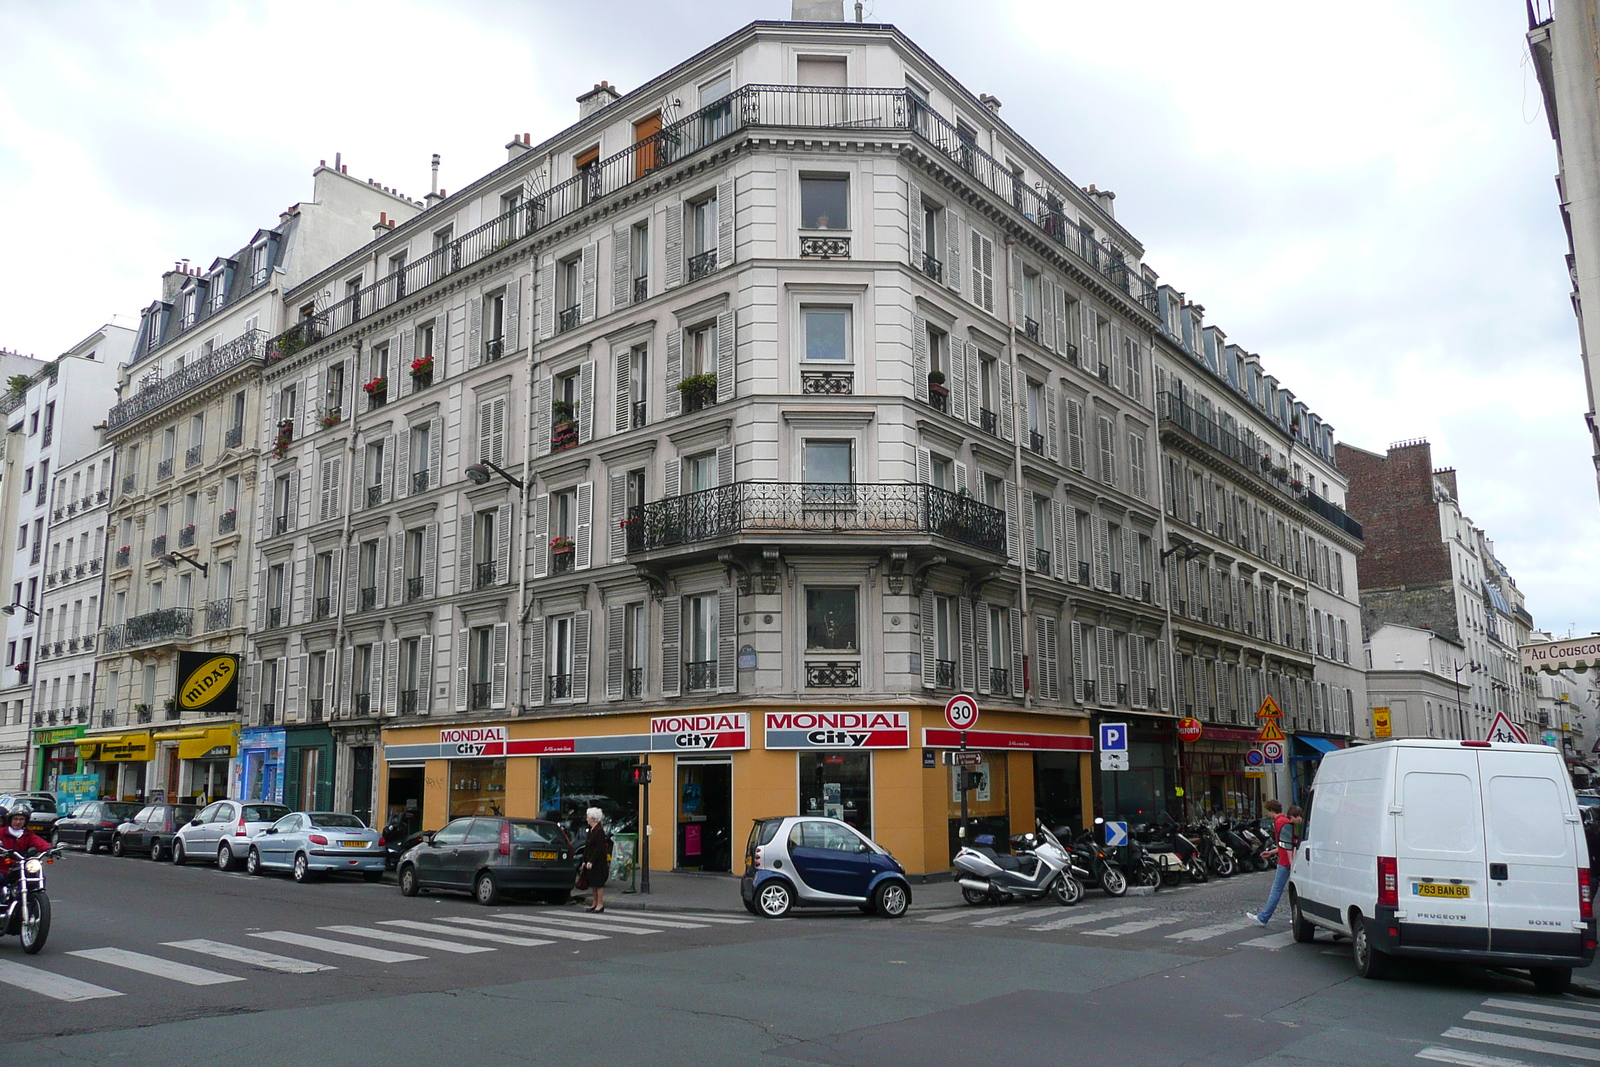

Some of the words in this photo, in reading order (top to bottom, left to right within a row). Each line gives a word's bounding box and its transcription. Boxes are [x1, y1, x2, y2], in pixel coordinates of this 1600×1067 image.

[185, 661, 231, 703] MIDAS
[952, 705, 971, 720] 30
[651, 714, 745, 733] MONDIAL
[766, 713, 907, 729] MONDIAL
[441, 728, 504, 743] MONDIAL
[676, 733, 716, 749] City
[808, 730, 868, 747] City
[1107, 729, 1120, 747] P
[457, 743, 484, 756] City
[1267, 746, 1278, 754] 30
[1418, 884, 1436, 894] 763
[1437, 885, 1455, 895] BAN
[1456, 886, 1468, 896] 60
